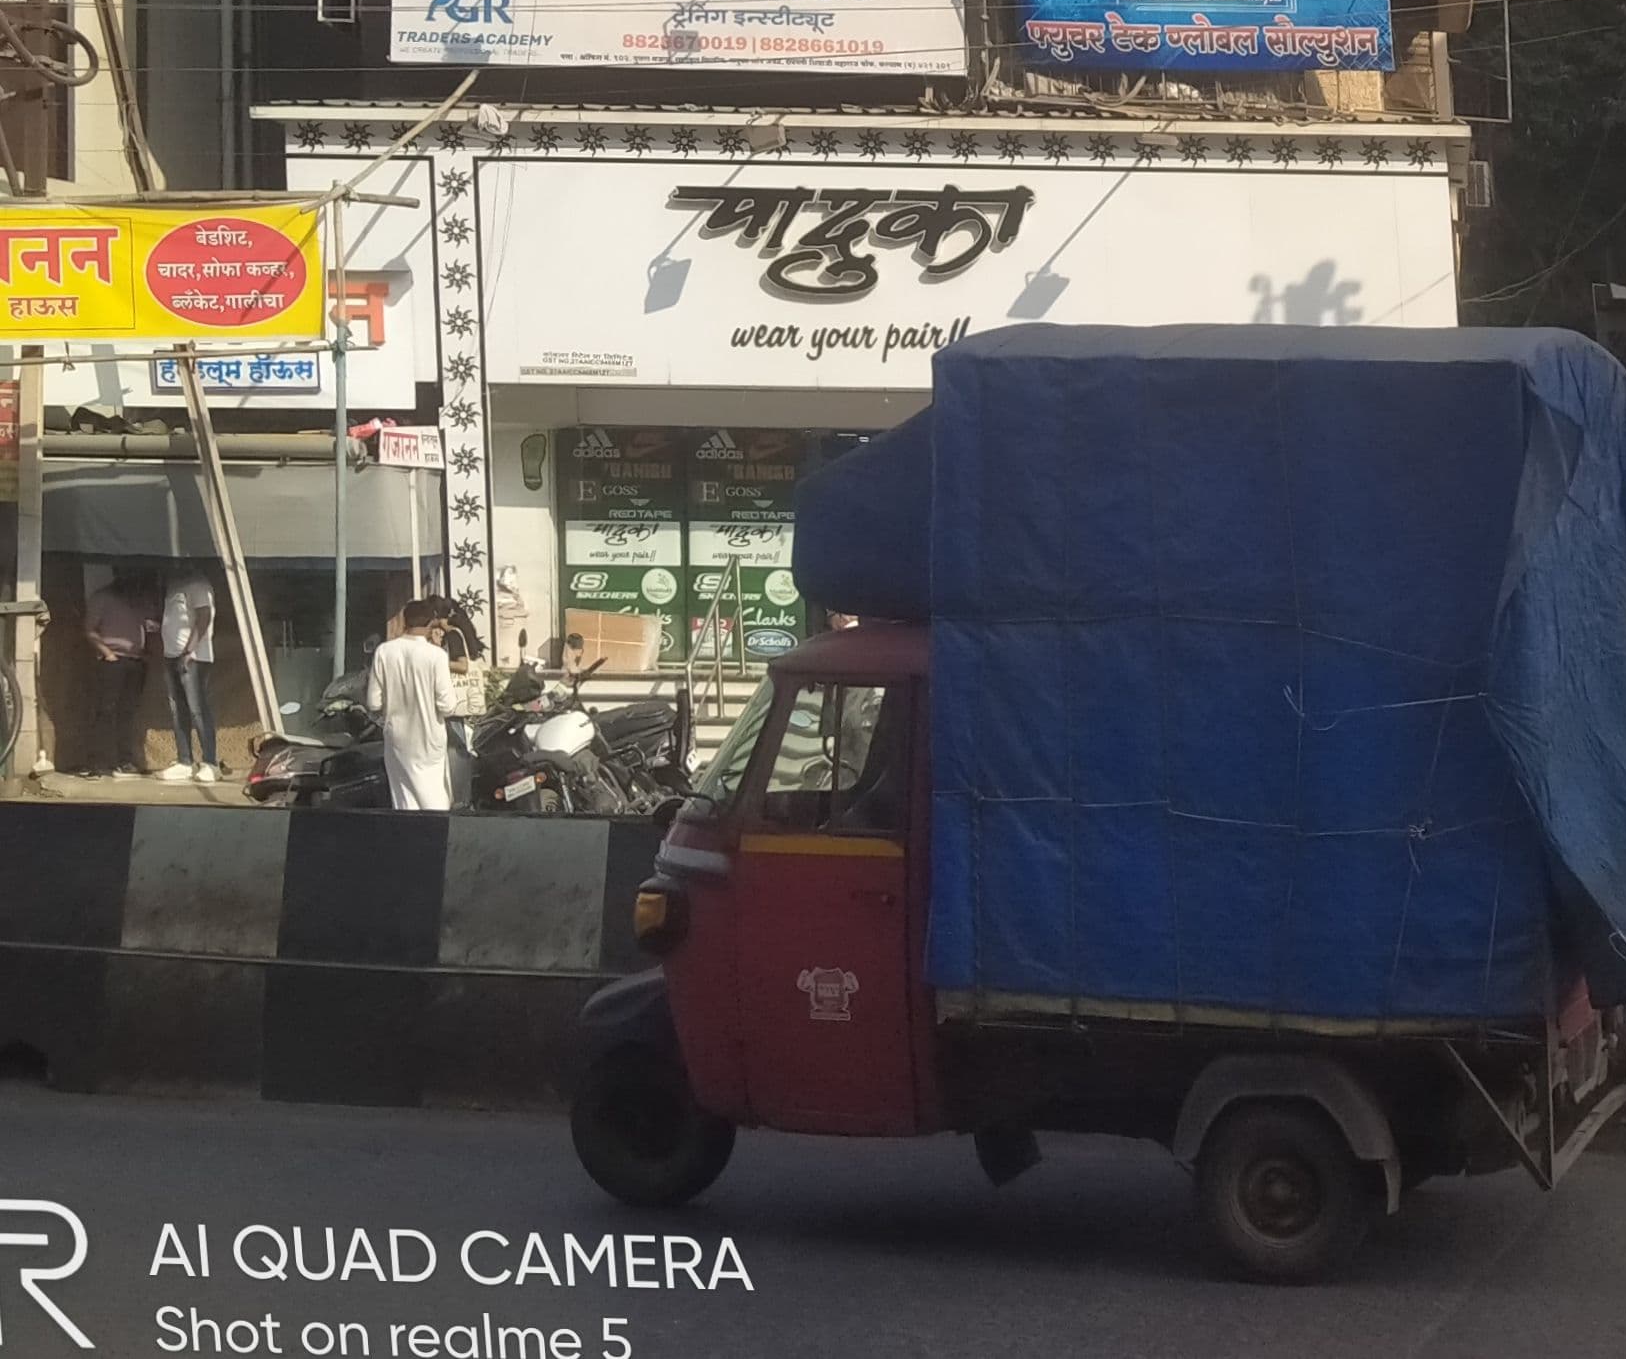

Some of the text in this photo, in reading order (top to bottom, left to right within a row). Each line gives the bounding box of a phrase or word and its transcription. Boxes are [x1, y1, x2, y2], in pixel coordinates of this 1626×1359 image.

[397, 30, 554, 47] TRADERS ACADEMY
[1105, 11, 1161, 53] टेक
[1163, 12, 1259, 56] ग्लोबल
[667, 184, 1037, 301] पादुका
[8, 296, 80, 318] हाऊस
[731, 322, 802, 350] wear
[807, 326, 877, 361] your
[572, 445, 620, 458] adidas
[695, 447, 744, 460] adidas
[575, 591, 640, 599] SKECHERS
